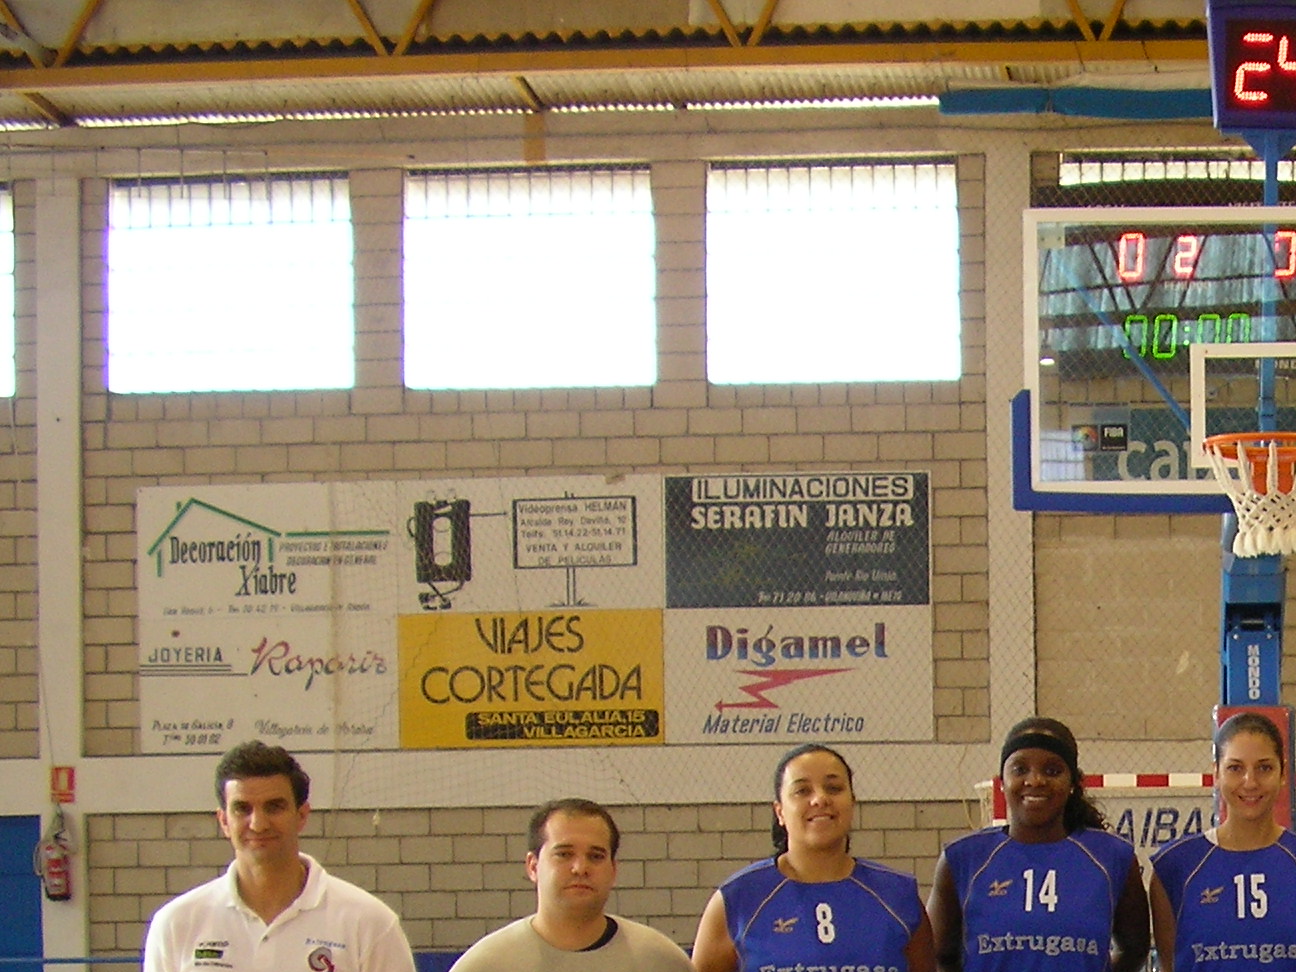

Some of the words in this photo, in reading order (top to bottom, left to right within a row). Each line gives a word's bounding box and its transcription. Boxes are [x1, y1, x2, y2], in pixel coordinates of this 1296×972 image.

[697, 477, 909, 500] ILUMINACIONES
[584, 501, 627, 512] HELMAN
[690, 503, 808, 530] SERAFIN
[825, 502, 914, 528] JANZA
[169, 532, 261, 565] Decoración
[526, 543, 558, 553] VENTA
[235, 564, 297, 597] Xiabre
[475, 615, 585, 654] VIAJES
[706, 622, 888, 667] Digamel
[148, 647, 224, 665] JOYERIA
[1247, 644, 1261, 700] MONDO
[420, 664, 642, 705] CORTEGADA
[478, 711, 538, 725] SANTA
[523, 725, 646, 738] VILLAGARCIA
[702, 713, 781, 734] Material
[786, 713, 865, 733] Electrico
[1115, 807, 1219, 849] AIBA
[1022, 869, 1058, 912] 14
[1233, 873, 1268, 919] 15
[815, 902, 836, 944] 8
[977, 932, 1099, 956] Extrugasa
